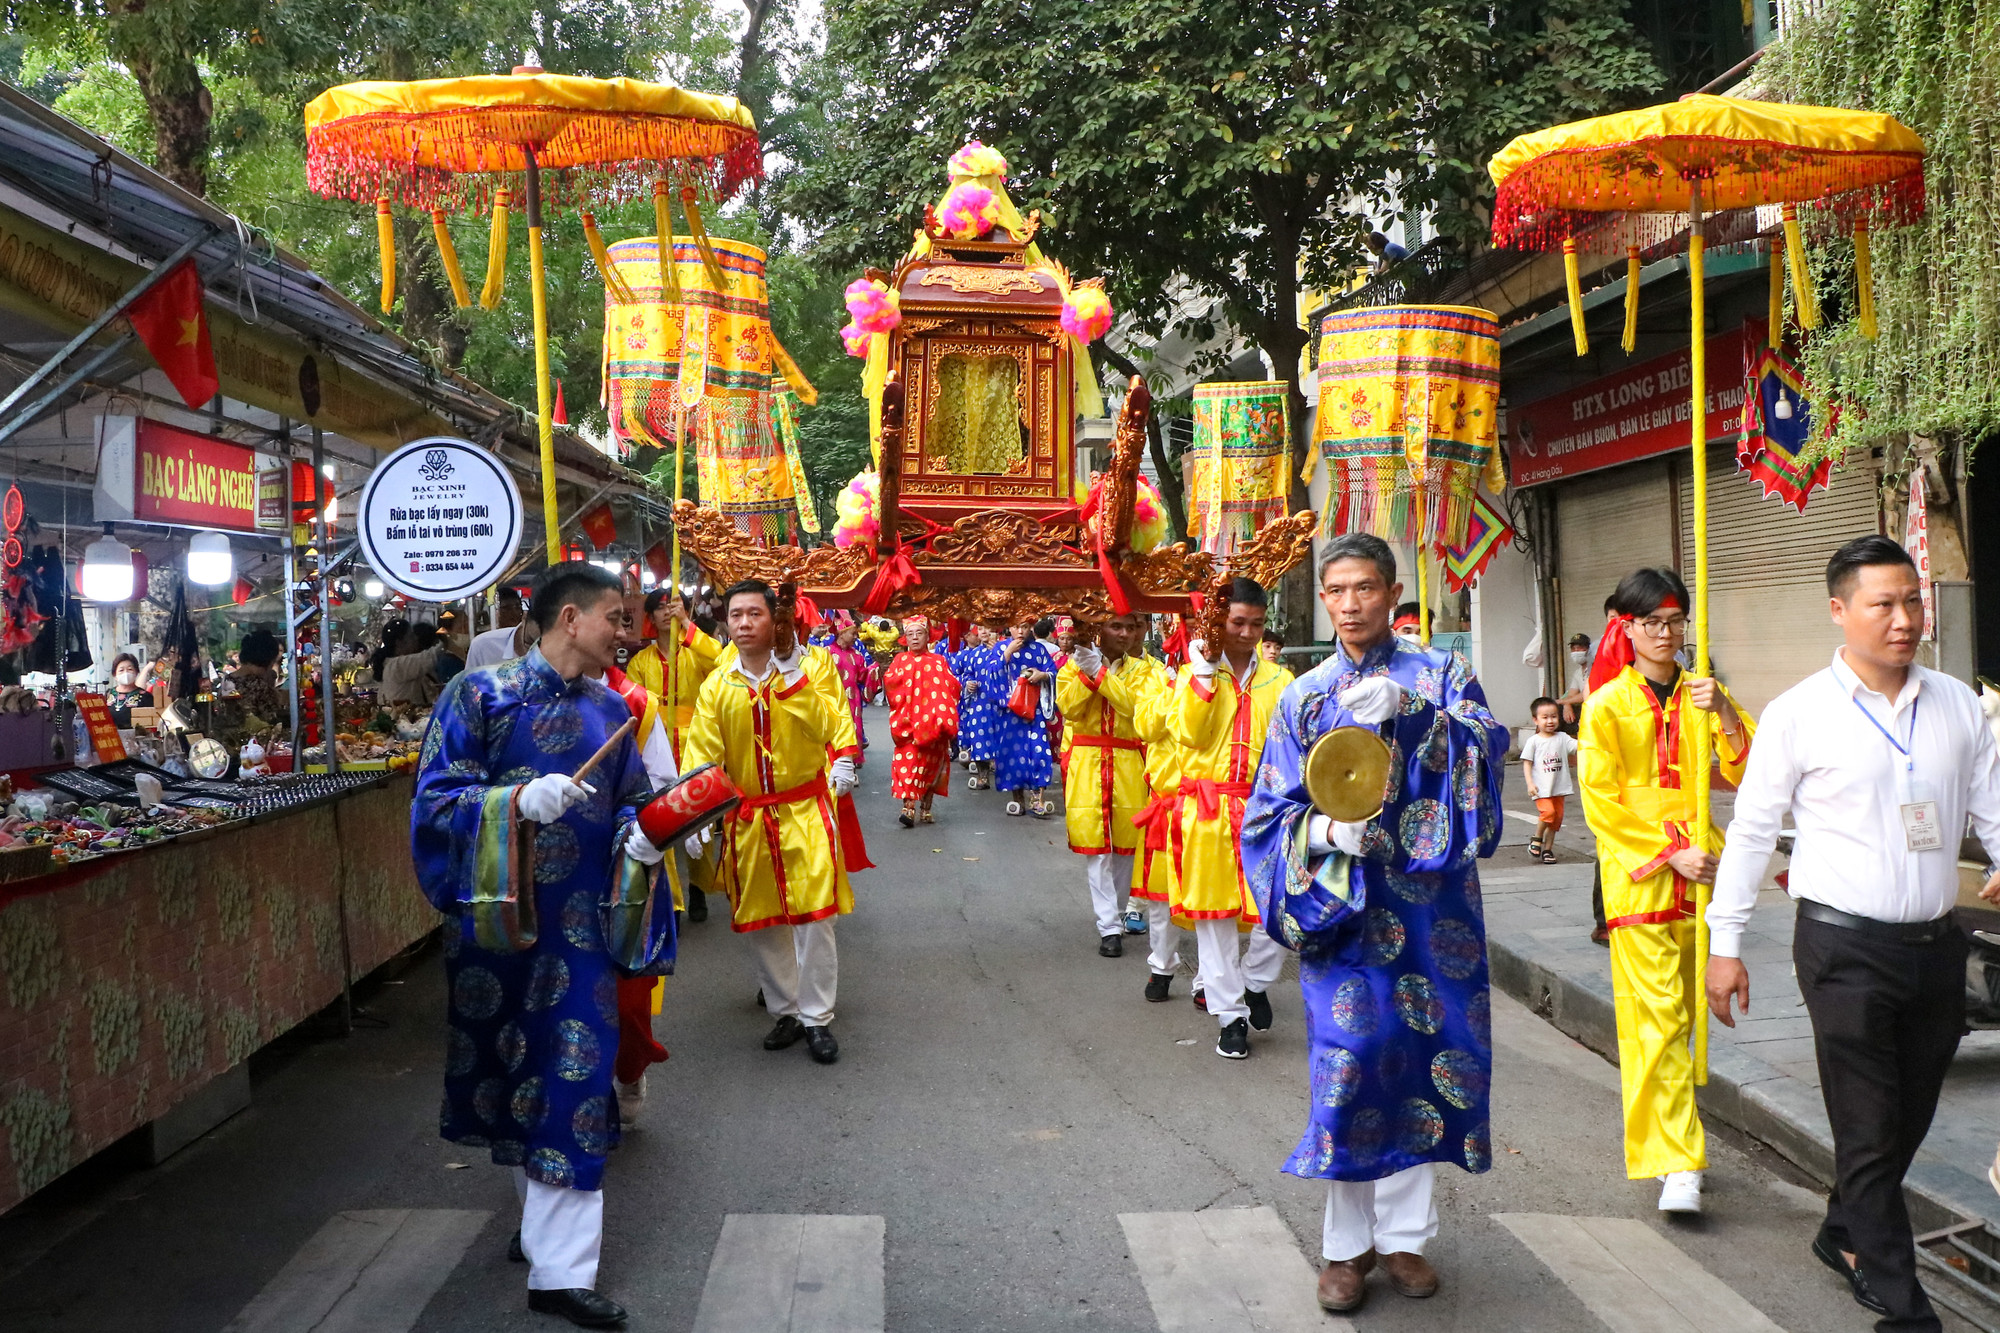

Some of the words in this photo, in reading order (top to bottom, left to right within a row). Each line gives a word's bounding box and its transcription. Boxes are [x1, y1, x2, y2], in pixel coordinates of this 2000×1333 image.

[1352, 387, 1367, 405] 佛
[1572, 392, 1606, 421] HTX
[1609, 376, 1655, 410] LONG
[1657, 357, 1693, 394] BIÊ
[1547, 433, 1575, 458] CHUYÊN
[1576, 427, 1593, 450] BÁN
[1620, 415, 1638, 438] BÁN
[1639, 405, 1650, 432] LẺ
[142, 452, 175, 510] BẠC
[177, 449, 217, 505] LÀNG
[219, 456, 254, 511] NGHỀ
[390, 506, 407, 521] Rửa
[408, 508, 425, 523] bạc
[427, 504, 440, 520] lấy
[442, 508, 464, 520] ngay
[466, 505, 489, 519] (30k)
[386, 524, 406, 540] Bấm
[408, 524, 417, 539] lỗ
[419, 525, 430, 538] tai
[433, 525, 443, 538] vô
[445, 524, 468, 538] trùng
[470, 524, 493, 538] (60k)
[404, 551, 423, 559] Zalo:
[425, 563, 444, 571] 0334
[445, 562, 459, 571] 654
[460, 561, 474, 570] 444
